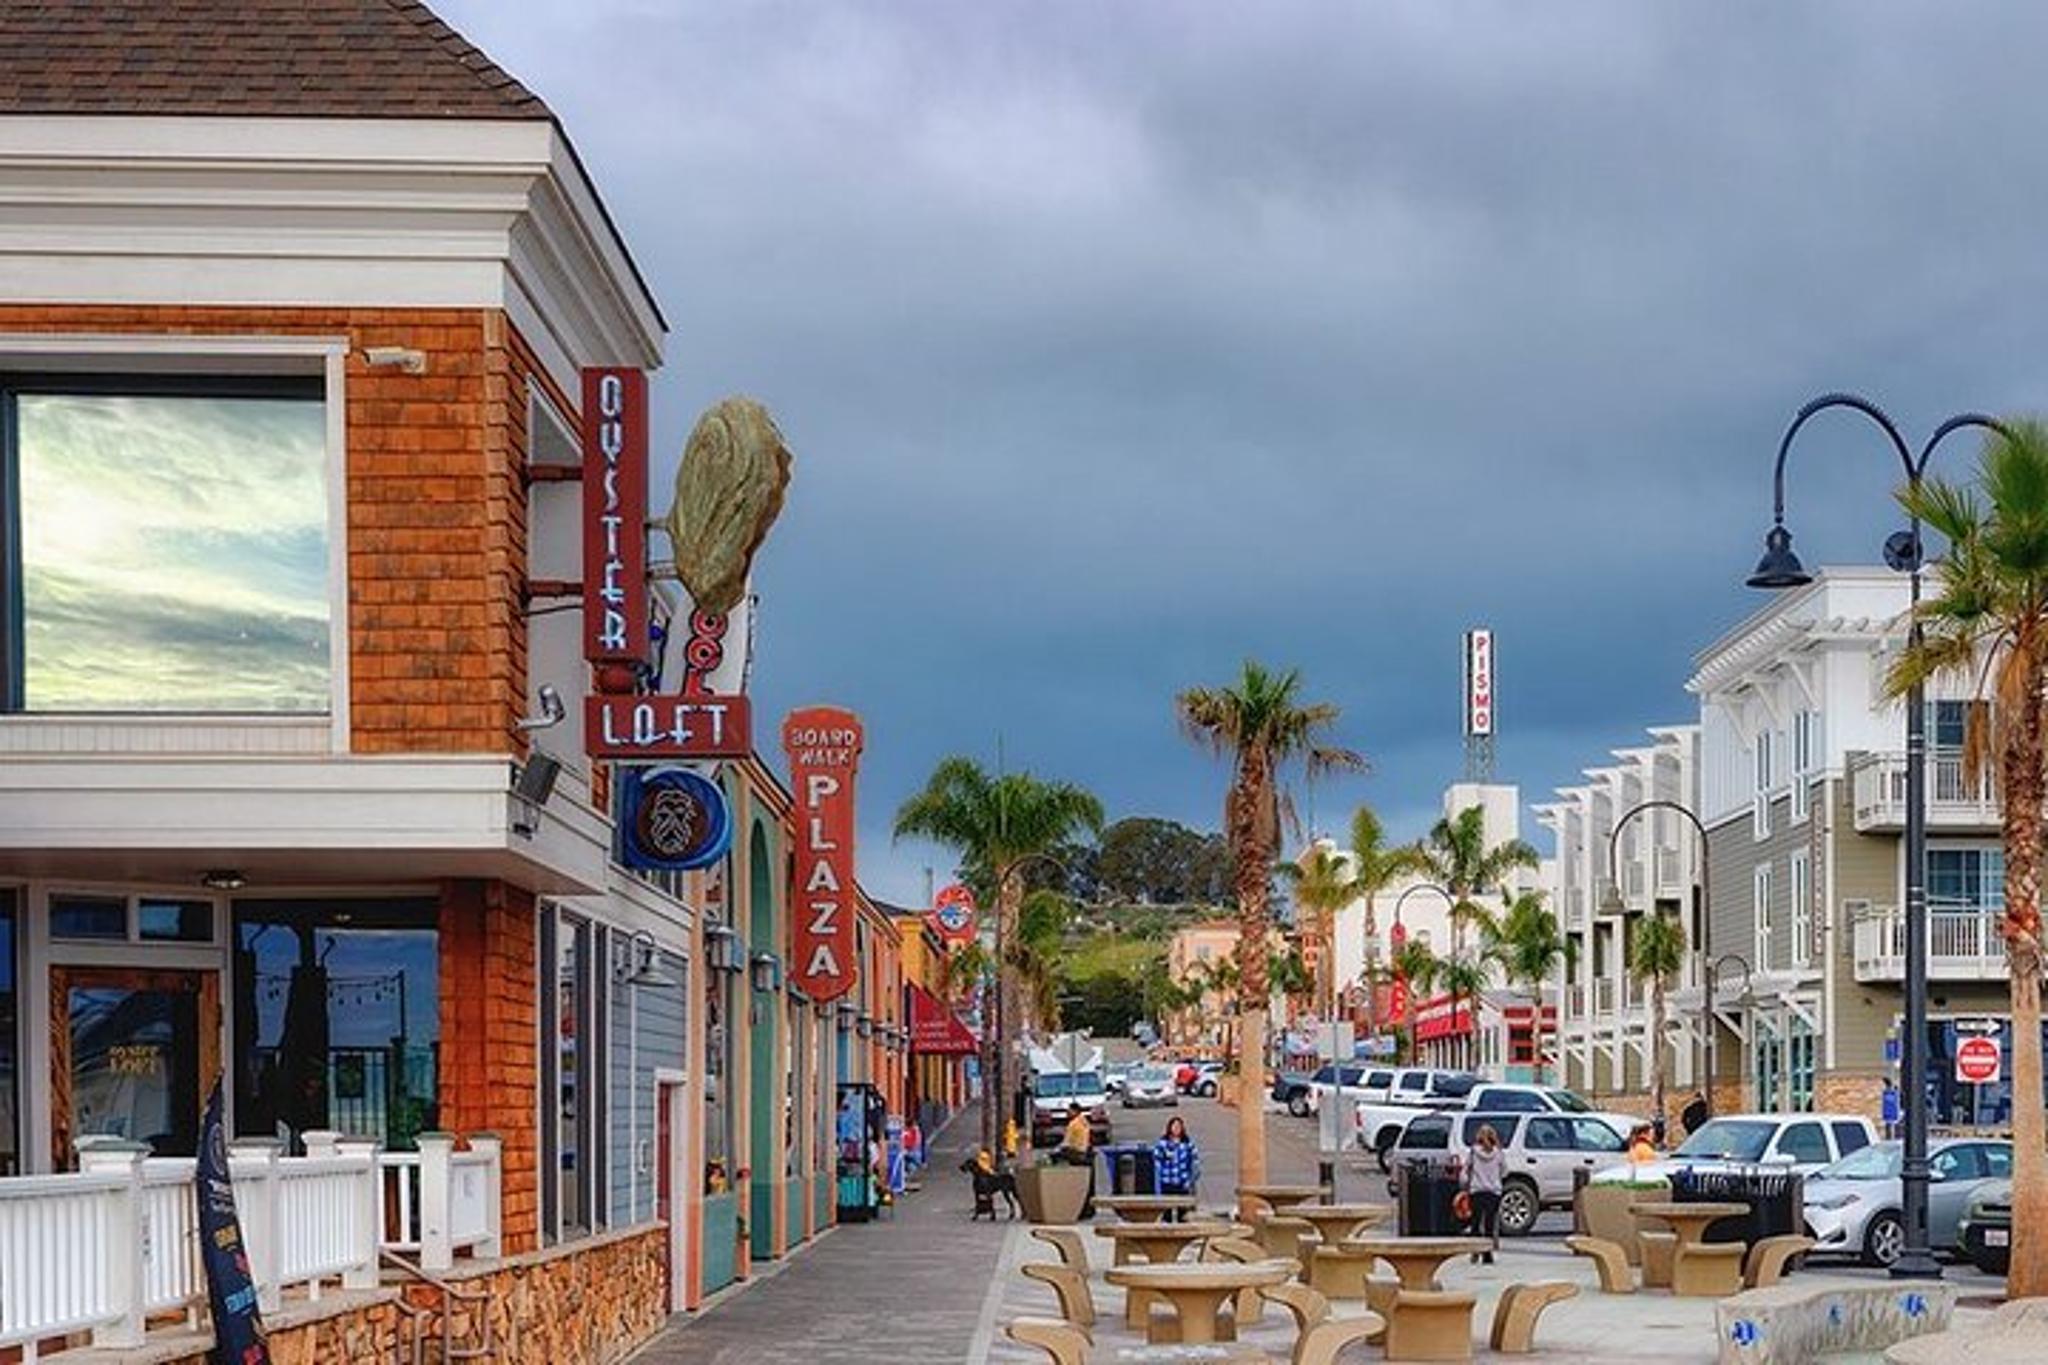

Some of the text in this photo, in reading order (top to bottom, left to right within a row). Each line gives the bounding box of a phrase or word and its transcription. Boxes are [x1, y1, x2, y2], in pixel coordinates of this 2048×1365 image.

[598, 374, 627, 650] OYSTER
[1475, 636, 1489, 728] PISMO
[602, 704, 728, 746] LOFT
[791, 727, 856, 747] BOARD
[800, 747, 849, 766] WALK
[807, 775, 840, 977] PLAZA
